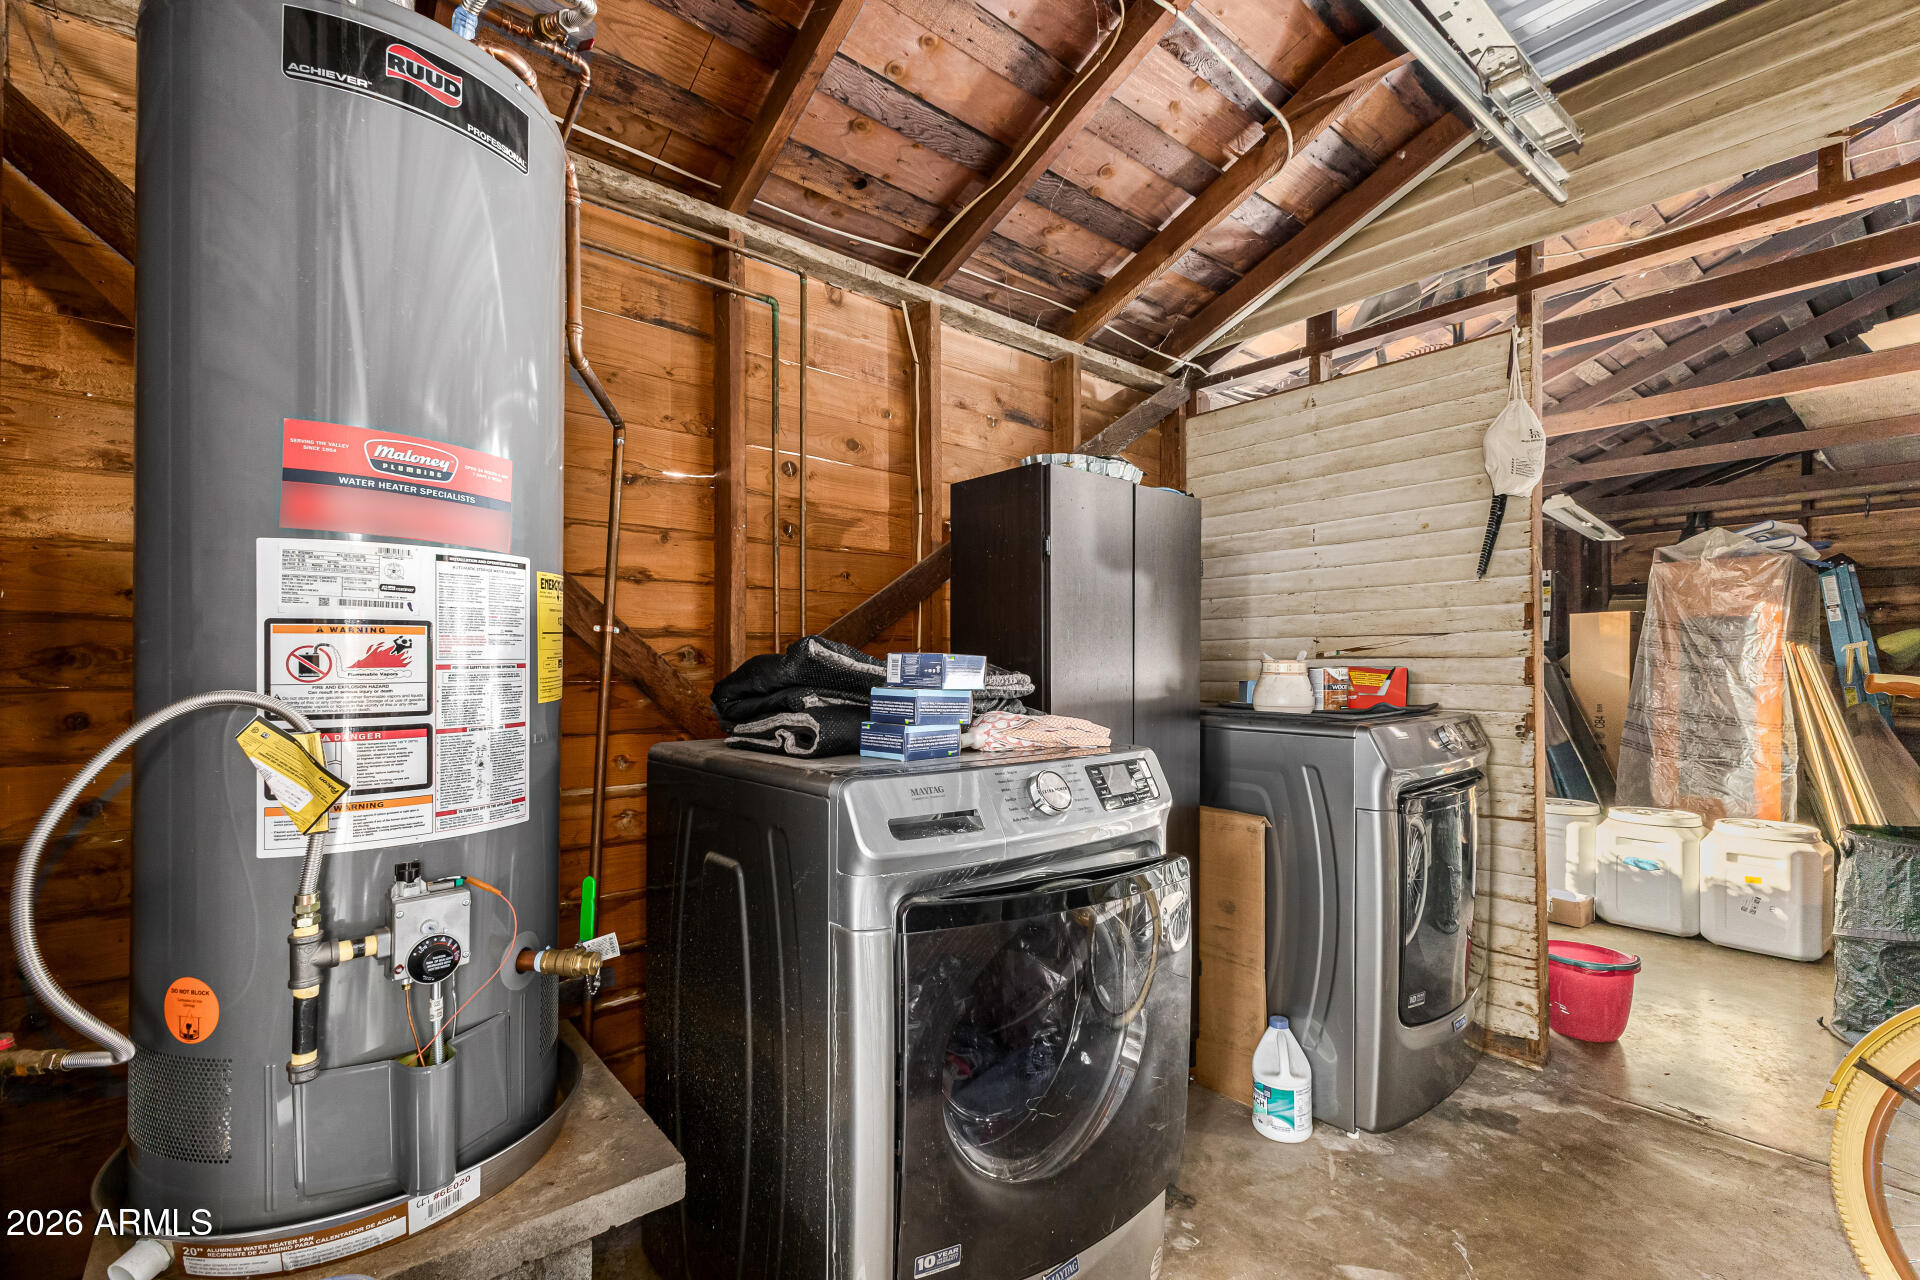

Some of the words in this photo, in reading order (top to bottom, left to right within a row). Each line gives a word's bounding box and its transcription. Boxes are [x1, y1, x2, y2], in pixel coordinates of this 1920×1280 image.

[387, 56, 462, 98] RUUD
[467, 123, 527, 168] PROFESSIONAL
[373, 444, 450, 472] Maloney
[382, 462, 442, 478] PLUMBING
[338, 476, 375, 488] WATER
[378, 481, 417, 494] HEATER
[419, 487, 476, 504] SPECIALISTS
[330, 626, 386, 634] WARNING
[910, 785, 945, 797] MAYTAG
[333, 801, 384, 812] WARNING
[433, 1175, 471, 1200] #6E020
[258, 1245, 293, 1254] ALUMINIO
[294, 1241, 315, 1249] PARA
[315, 1226, 365, 1244] CALENTADOR
[365, 1222, 376, 1230] DE
[269, 1239, 298, 1248] HEATER
[299, 1235, 314, 1243] PAN
[917, 1255, 936, 1271] 10
[937, 1247, 959, 1258] YEAR
